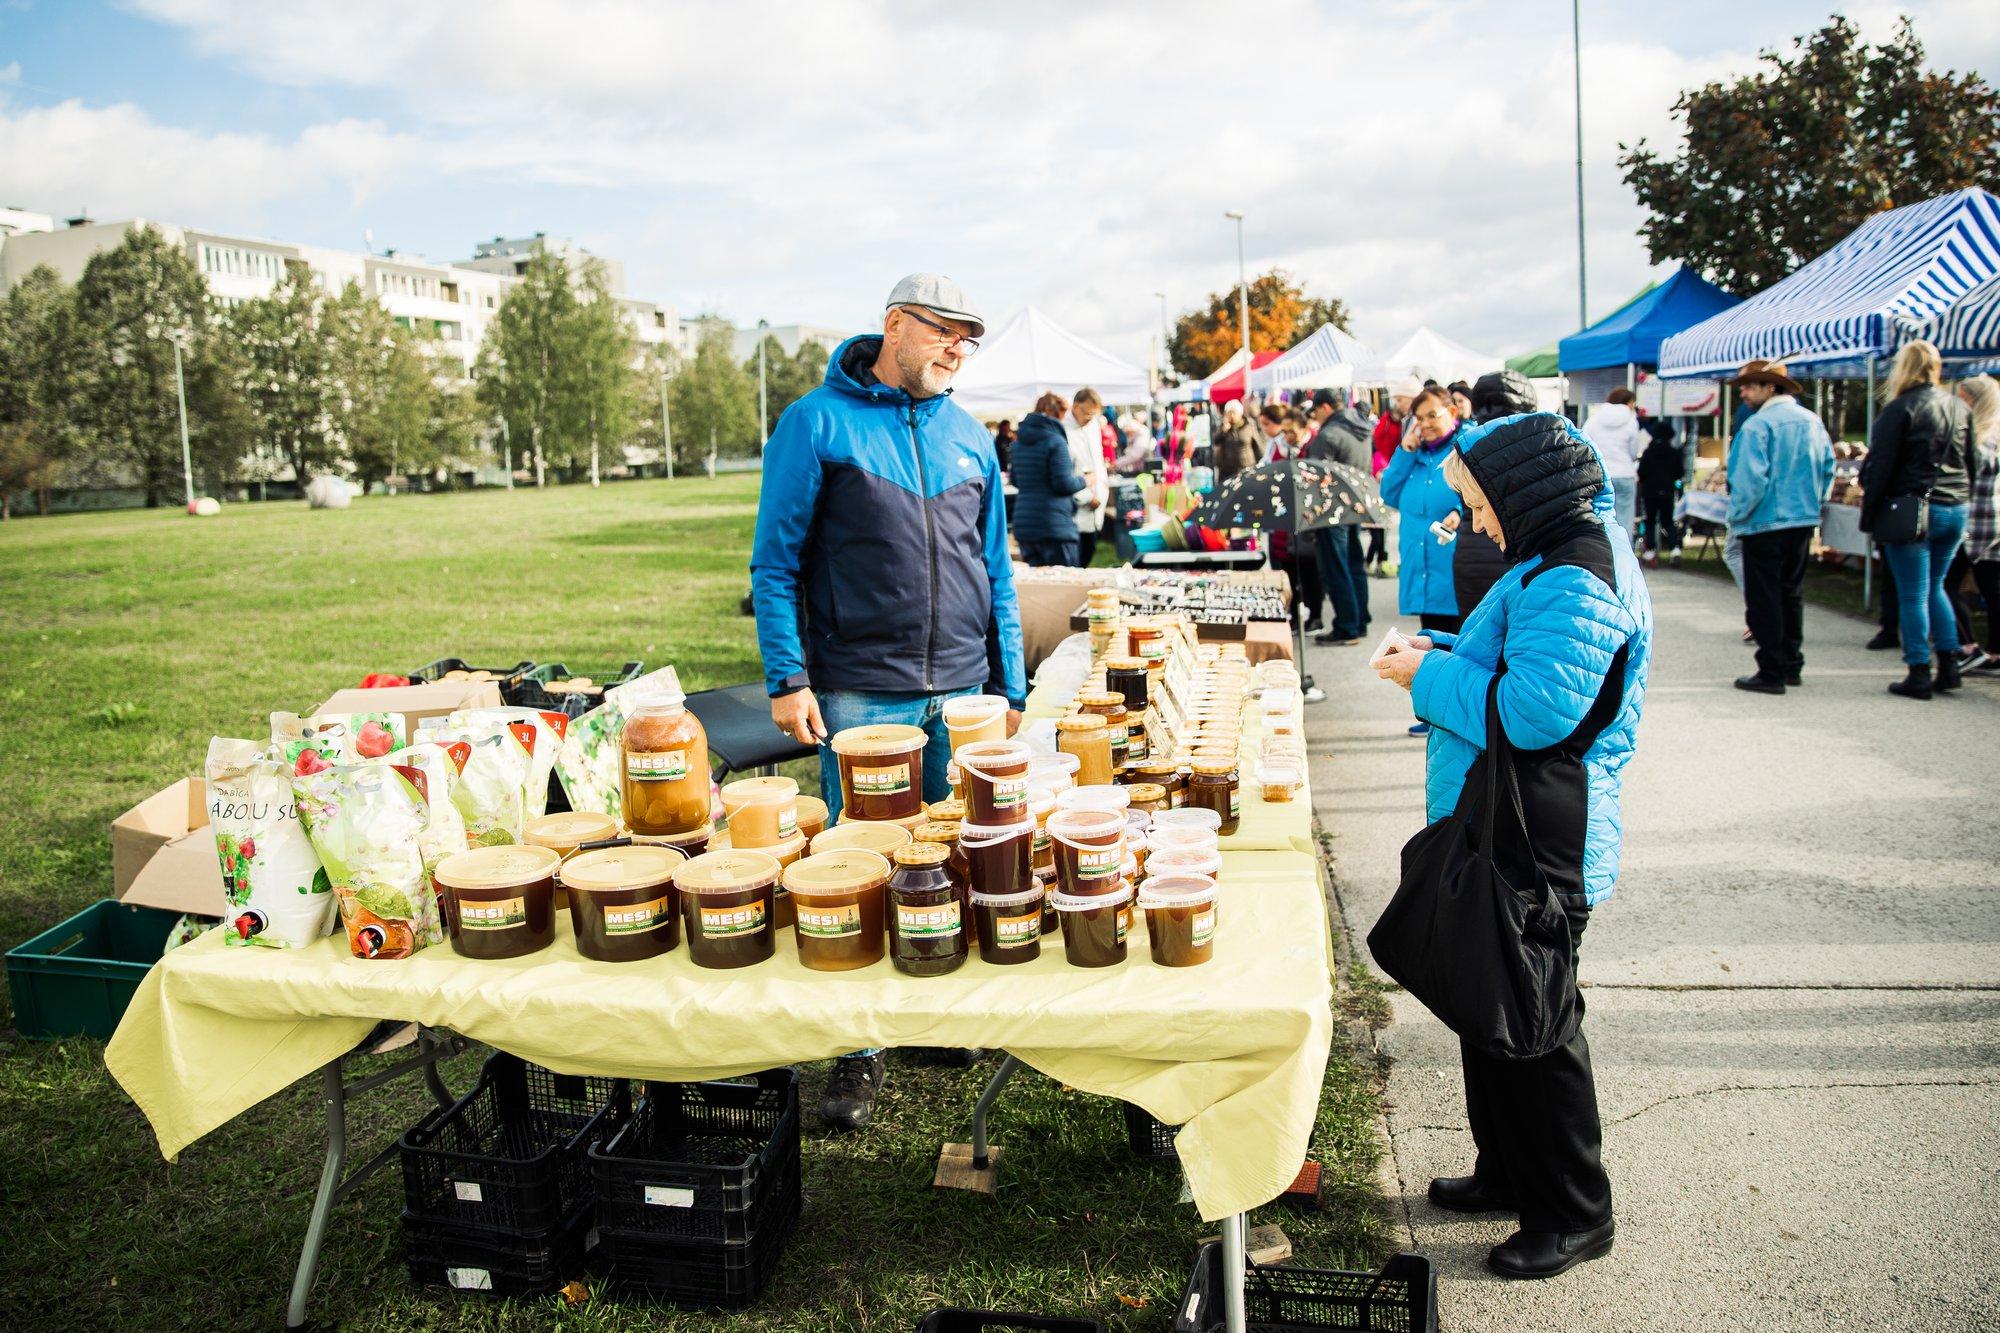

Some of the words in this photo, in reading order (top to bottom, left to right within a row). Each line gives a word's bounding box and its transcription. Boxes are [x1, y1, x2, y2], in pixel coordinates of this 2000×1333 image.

[553, 720, 562, 730] 3L
[521, 732, 531, 743] 3L
[454, 750, 464, 761] 3L
[629, 757, 670, 770] MESI
[415, 777, 424, 789] 3L
[854, 773, 893, 784] MESI
[462, 907, 504, 919] MESI
[607, 909, 652, 924] MESI
[704, 910, 753, 926] MESI
[799, 912, 839, 926] MESI
[900, 910, 949, 926] MESI
[1000, 916, 1040, 935] MESI
